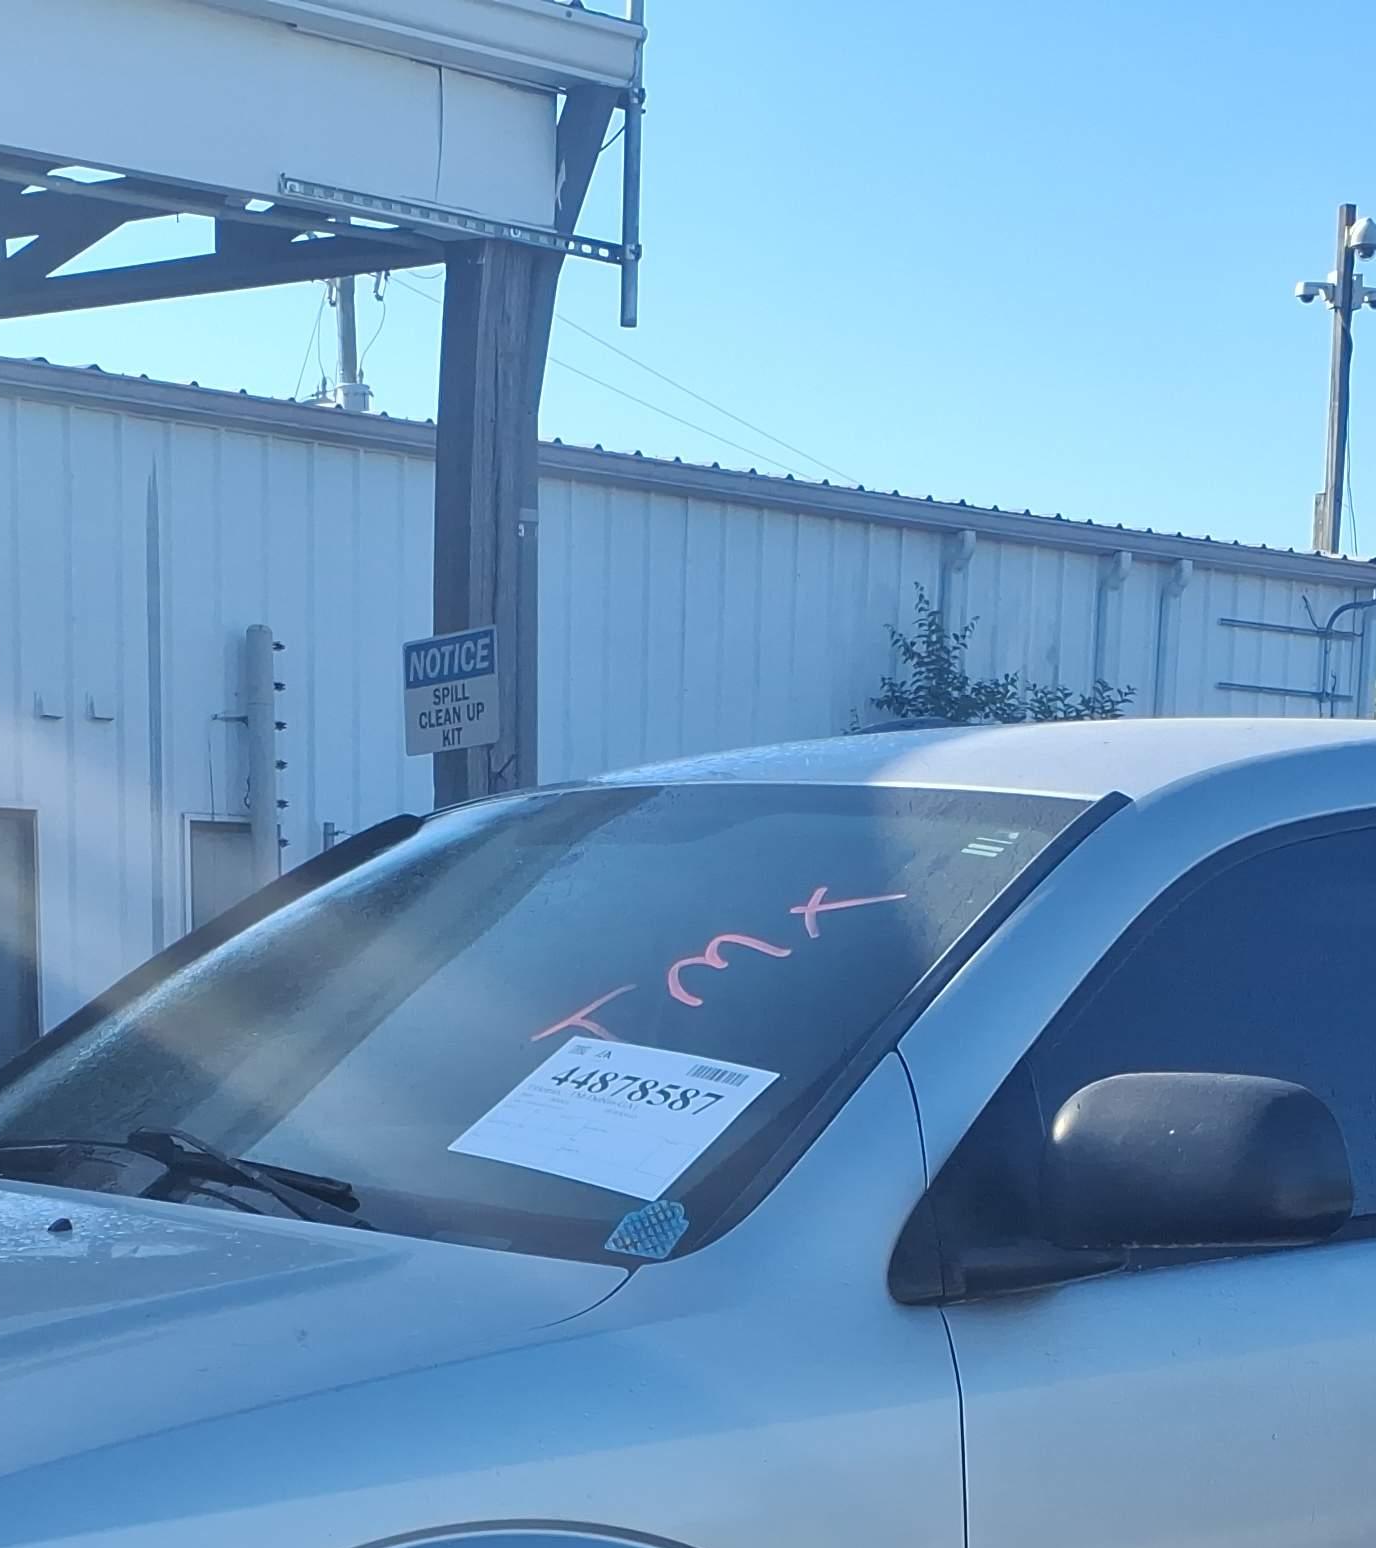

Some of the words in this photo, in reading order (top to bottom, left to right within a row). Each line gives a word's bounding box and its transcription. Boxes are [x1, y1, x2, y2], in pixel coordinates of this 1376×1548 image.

[409, 637, 491, 682] NOTICE
[432, 683, 470, 706] SPILL
[419, 706, 461, 729] CLEAN
[466, 702, 485, 721] UP
[442, 727, 463, 747] KIT
[551, 1065, 725, 1116] 44878587
